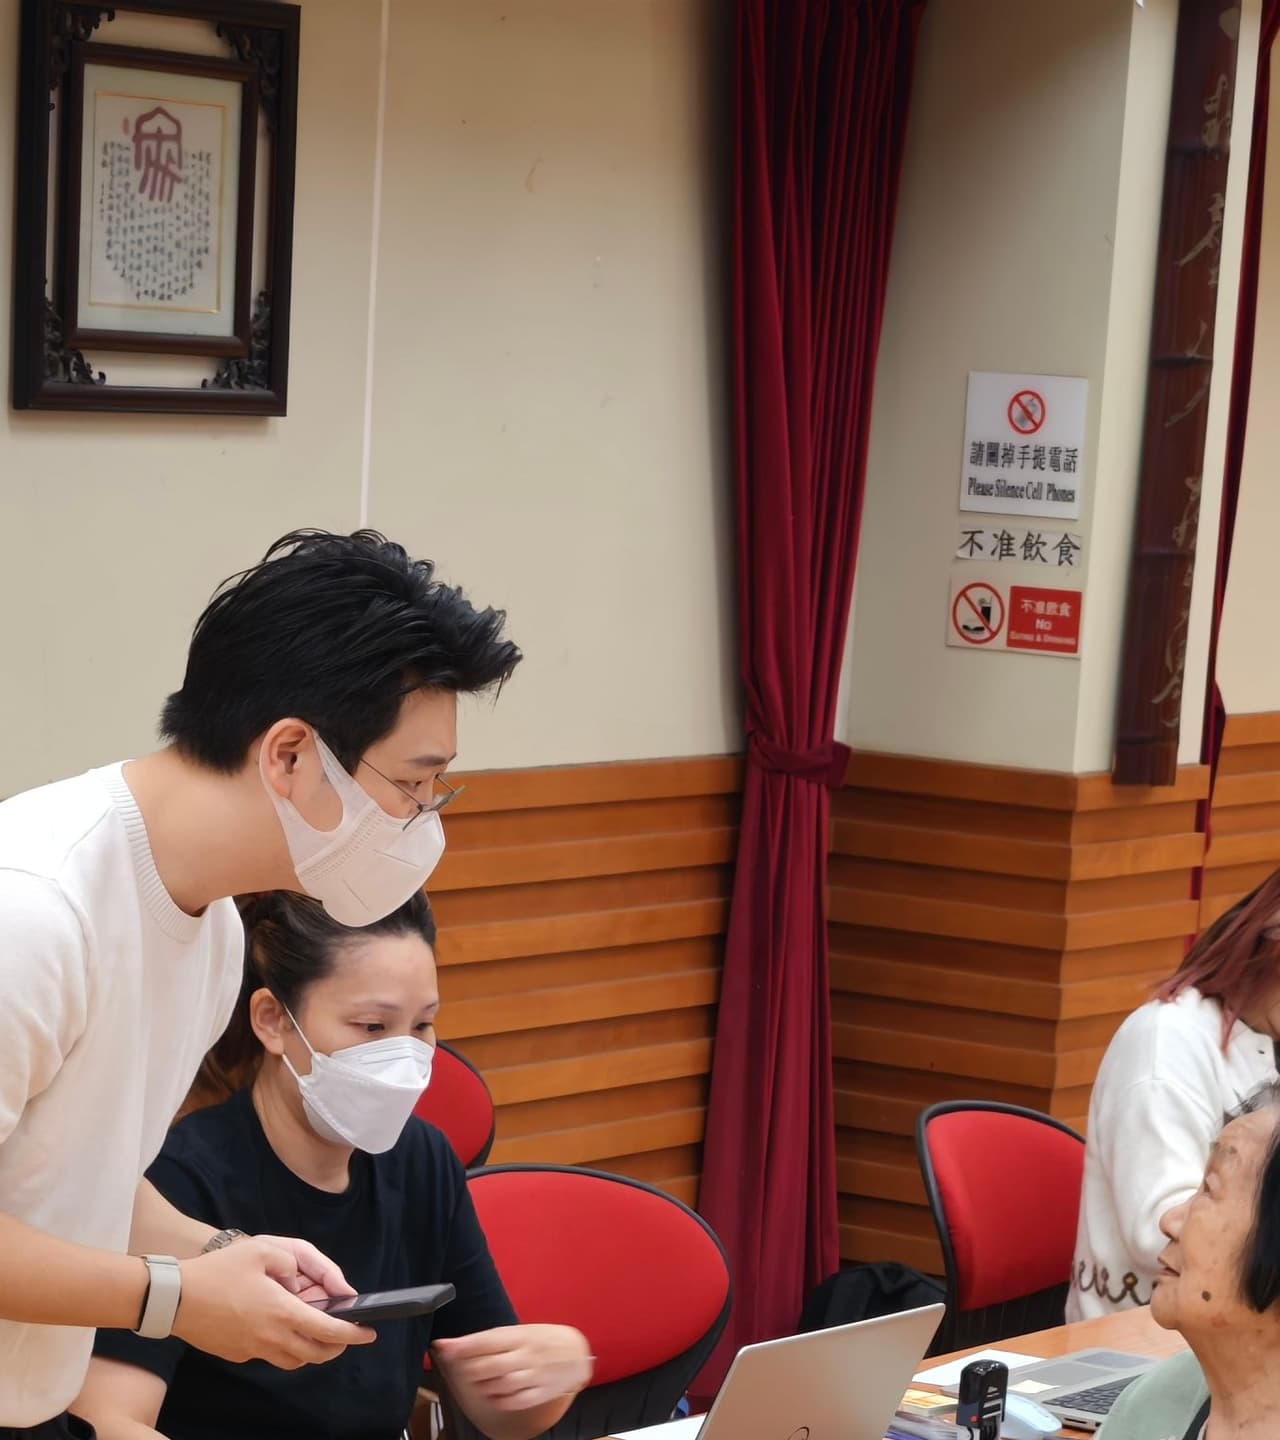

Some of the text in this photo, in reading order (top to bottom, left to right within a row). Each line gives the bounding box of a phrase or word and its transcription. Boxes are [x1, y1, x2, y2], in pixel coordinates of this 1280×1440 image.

[969, 440, 1079, 473] 請關掉手提電話
[967, 476, 1076, 503] Please Silence Cell Phones
[958, 528, 1081, 567] 不准飲食
